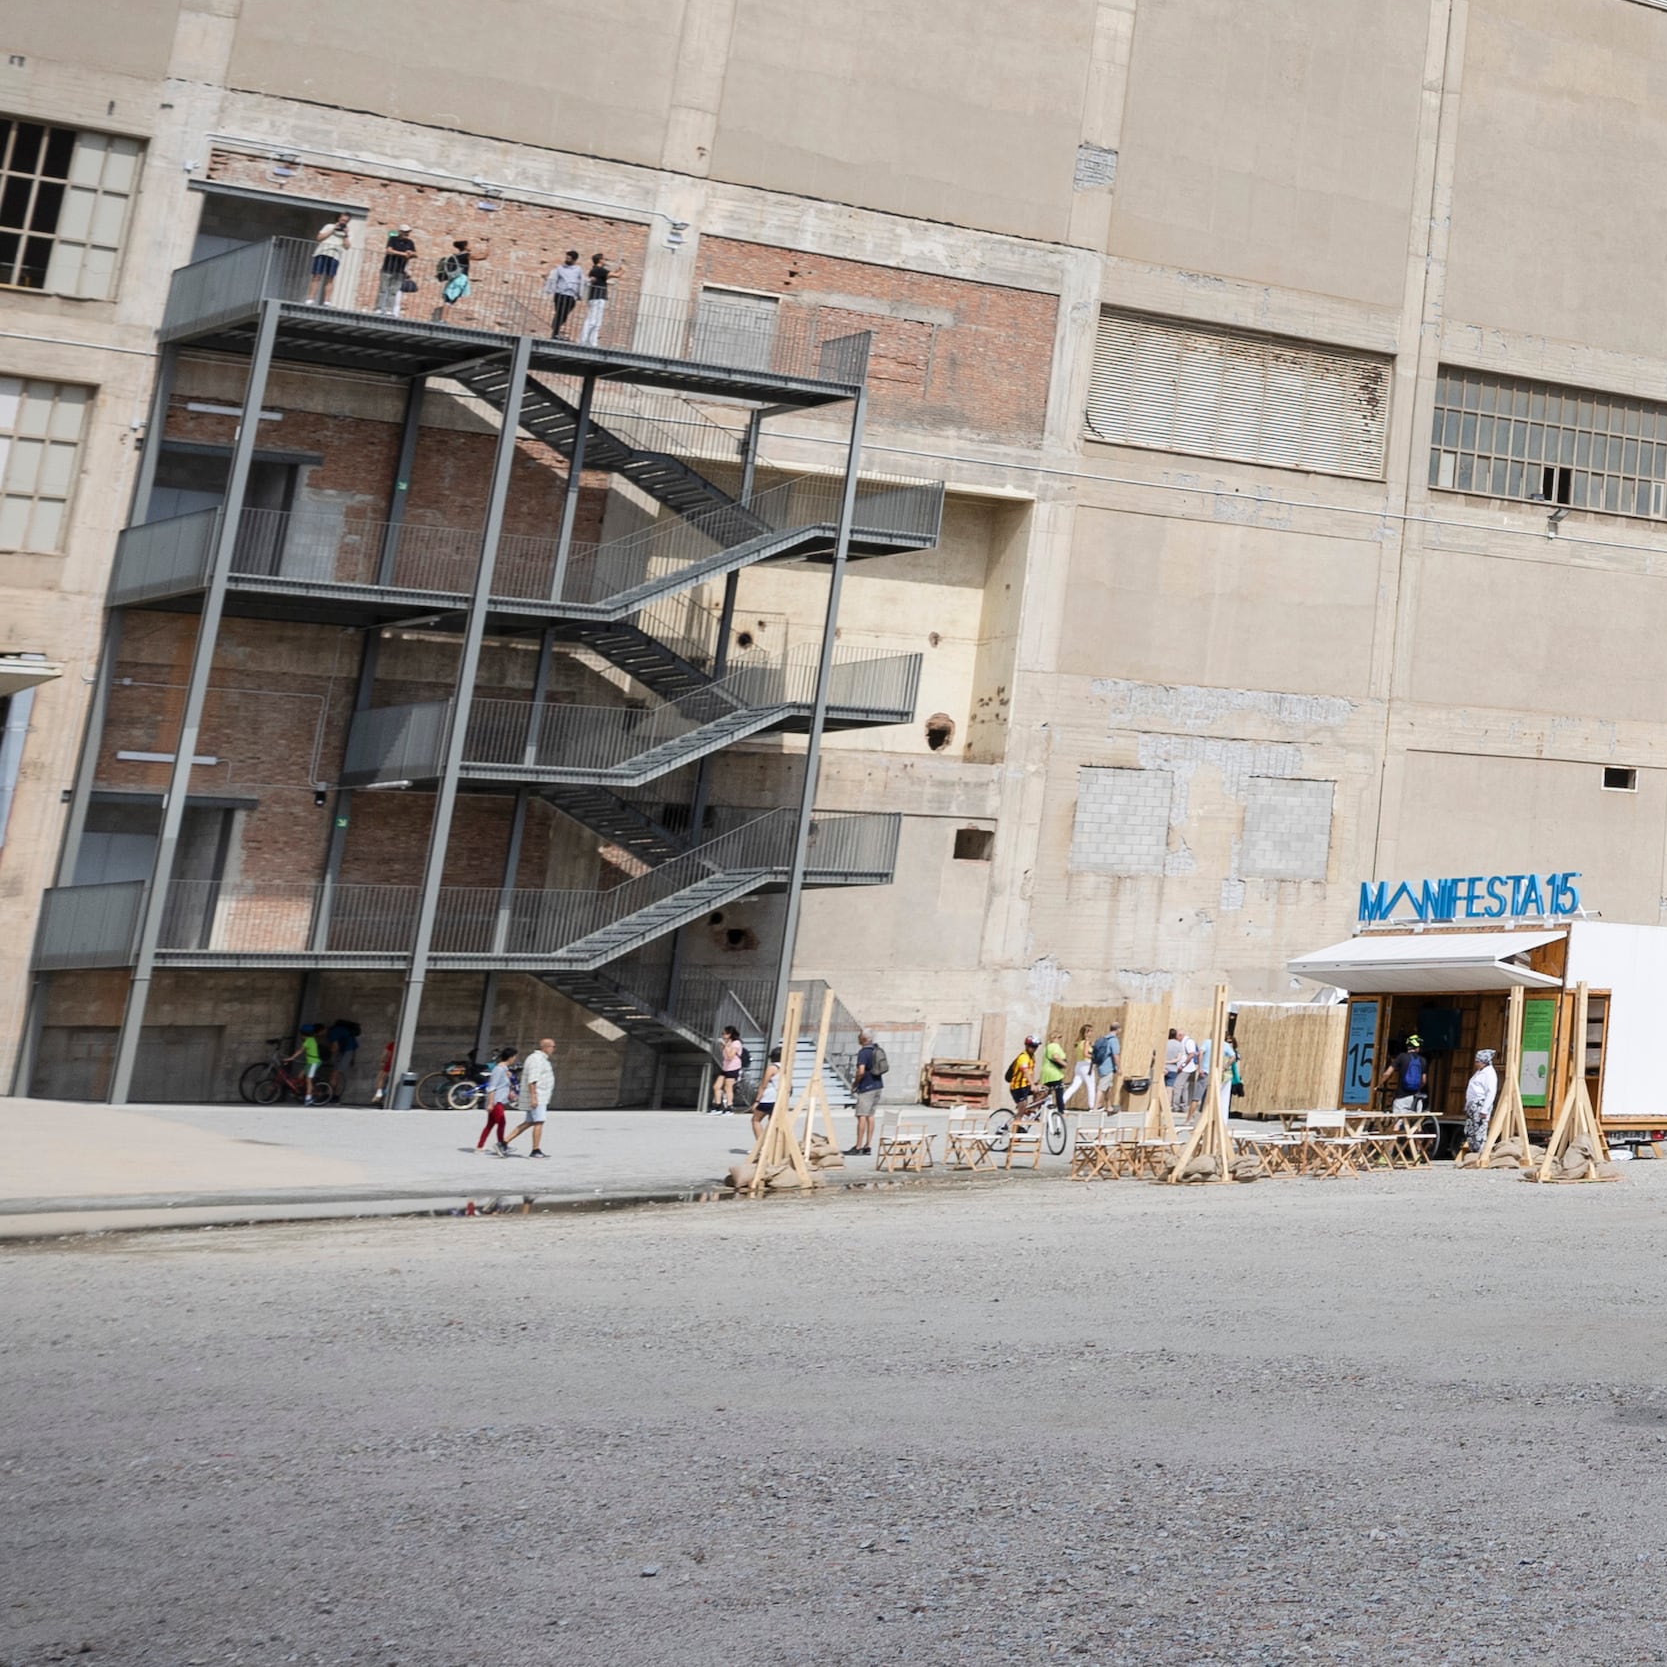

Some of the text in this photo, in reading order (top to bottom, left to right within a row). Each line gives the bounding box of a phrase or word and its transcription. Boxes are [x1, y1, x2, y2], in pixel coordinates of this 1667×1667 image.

[1358, 872, 1582, 921] MANIFESTA 15
[1349, 1043, 1374, 1088] 15
